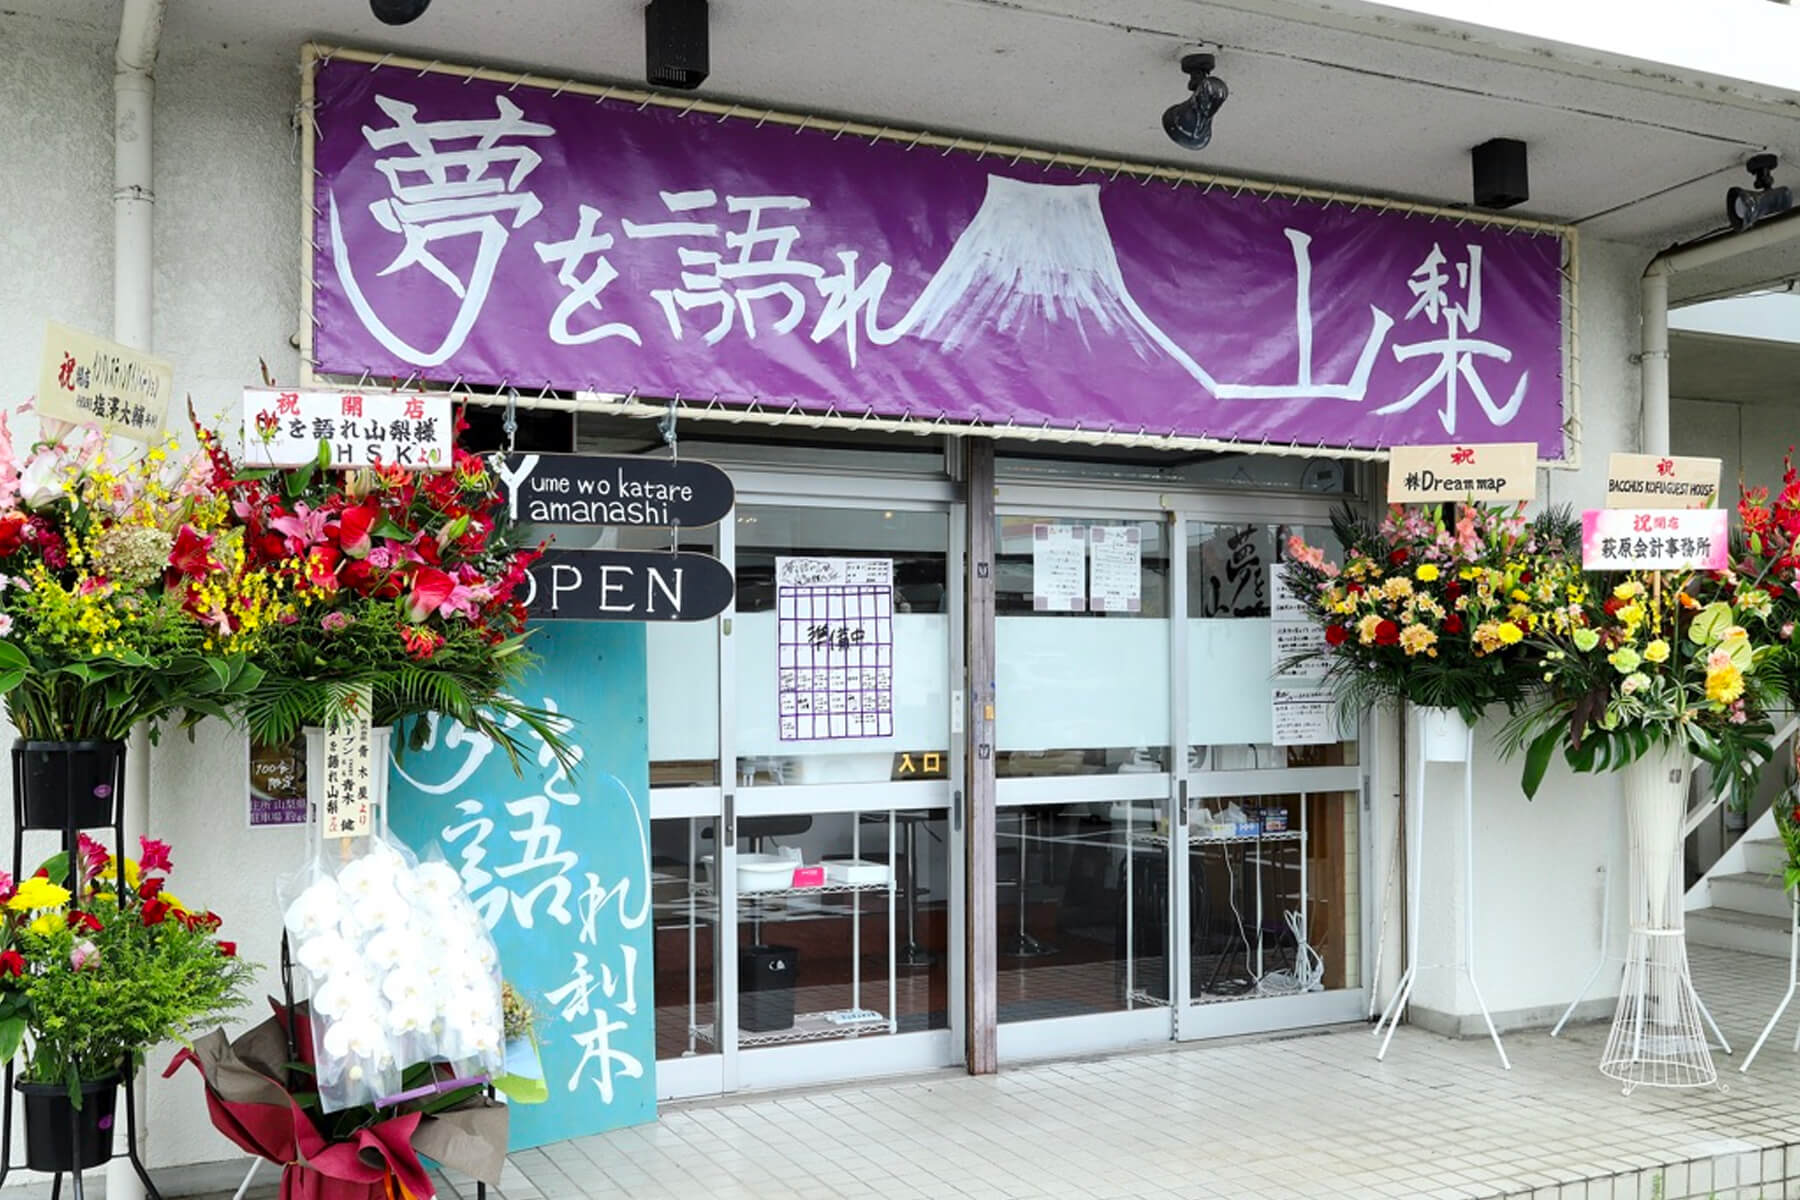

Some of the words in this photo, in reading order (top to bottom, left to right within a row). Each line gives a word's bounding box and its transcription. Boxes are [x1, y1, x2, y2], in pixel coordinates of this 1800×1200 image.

[328, 94, 905, 368] 夢を語れ
[1213, 227, 1528, 435] 山梨
[58, 351, 76, 392] 祝
[262, 417, 438, 442] を語れ山梨様
[1451, 447, 1476, 465] 祝
[1656, 458, 1675, 477] 祝
[577, 479, 610, 496] wo
[618, 466, 694, 501] katare
[899, 753, 940, 773] 入口
